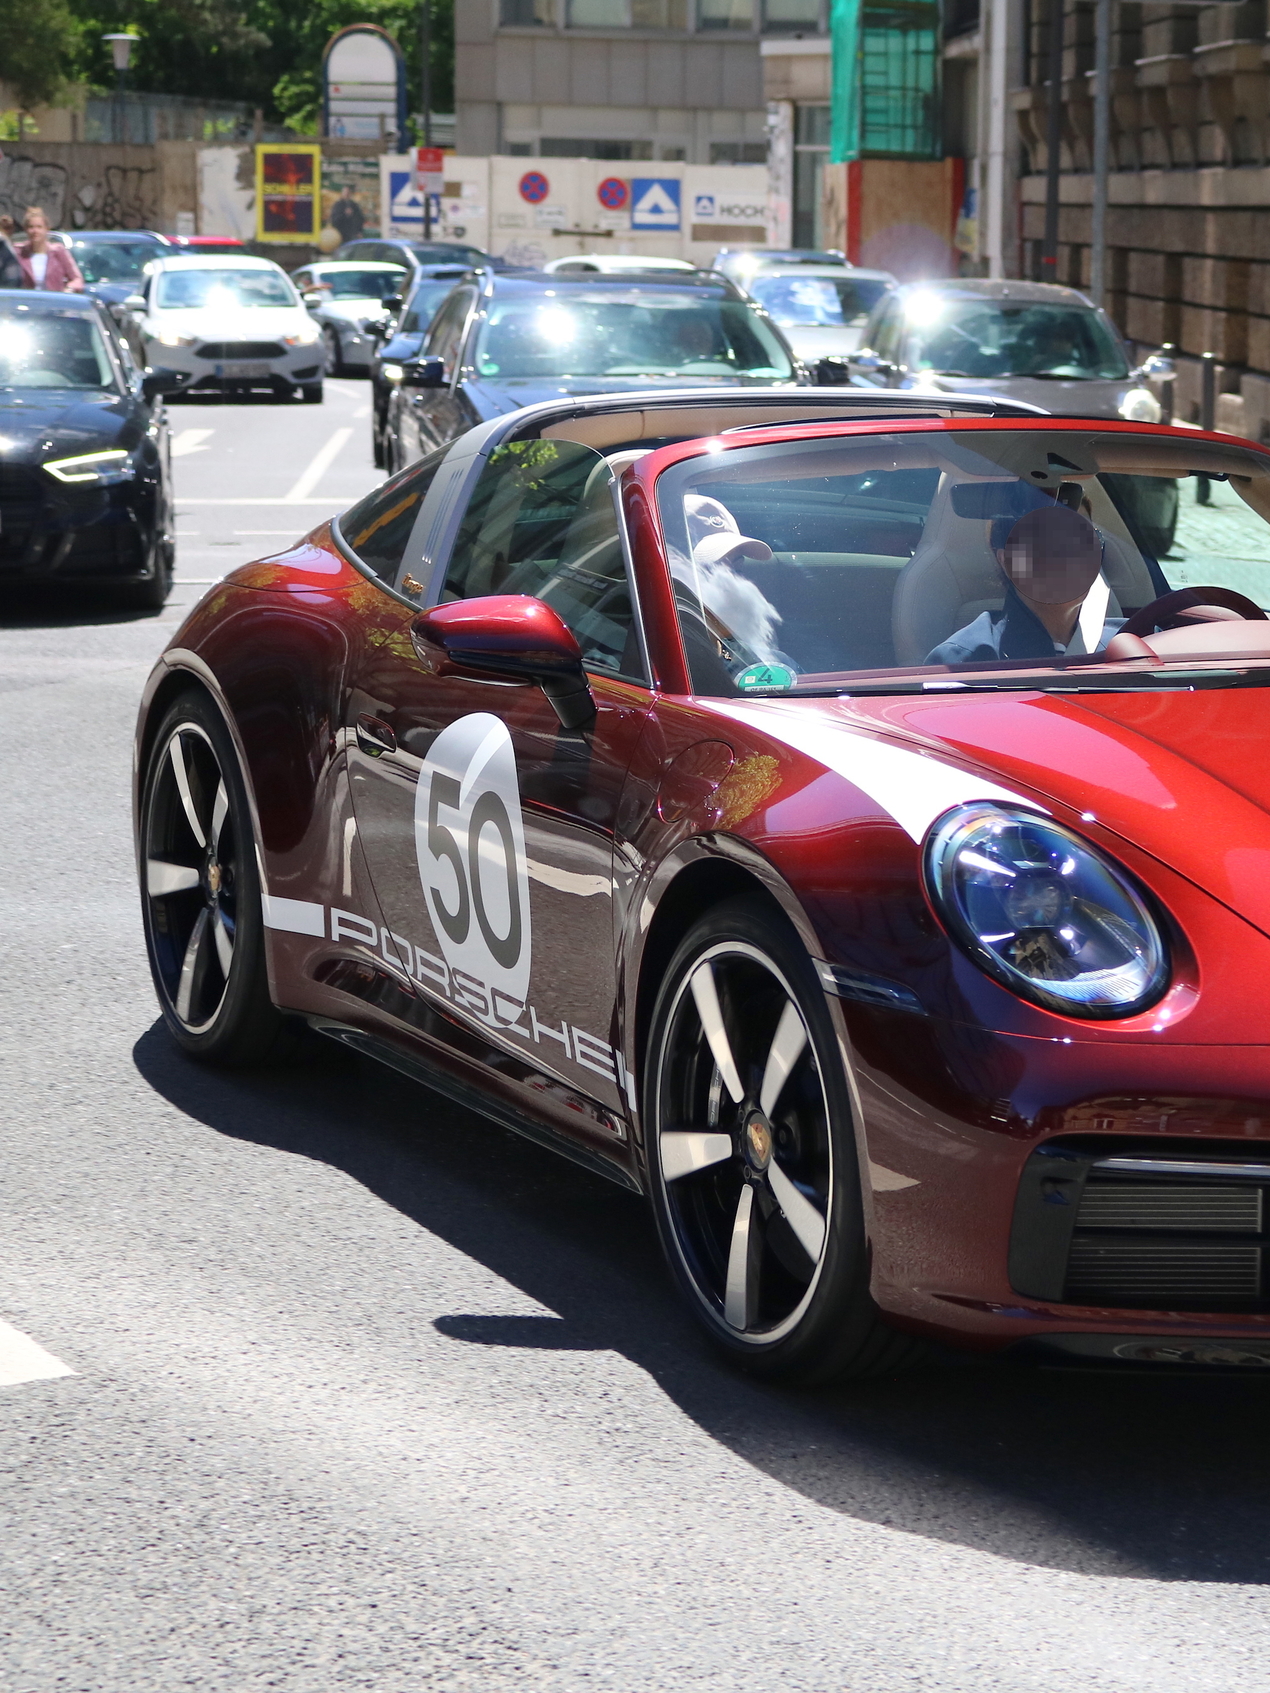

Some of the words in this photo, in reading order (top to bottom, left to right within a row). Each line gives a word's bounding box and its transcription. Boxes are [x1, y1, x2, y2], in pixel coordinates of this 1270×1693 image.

[758, 669, 773, 683] 4
[428, 770, 522, 970] 50
[330, 906, 618, 1084] PORSCHE
